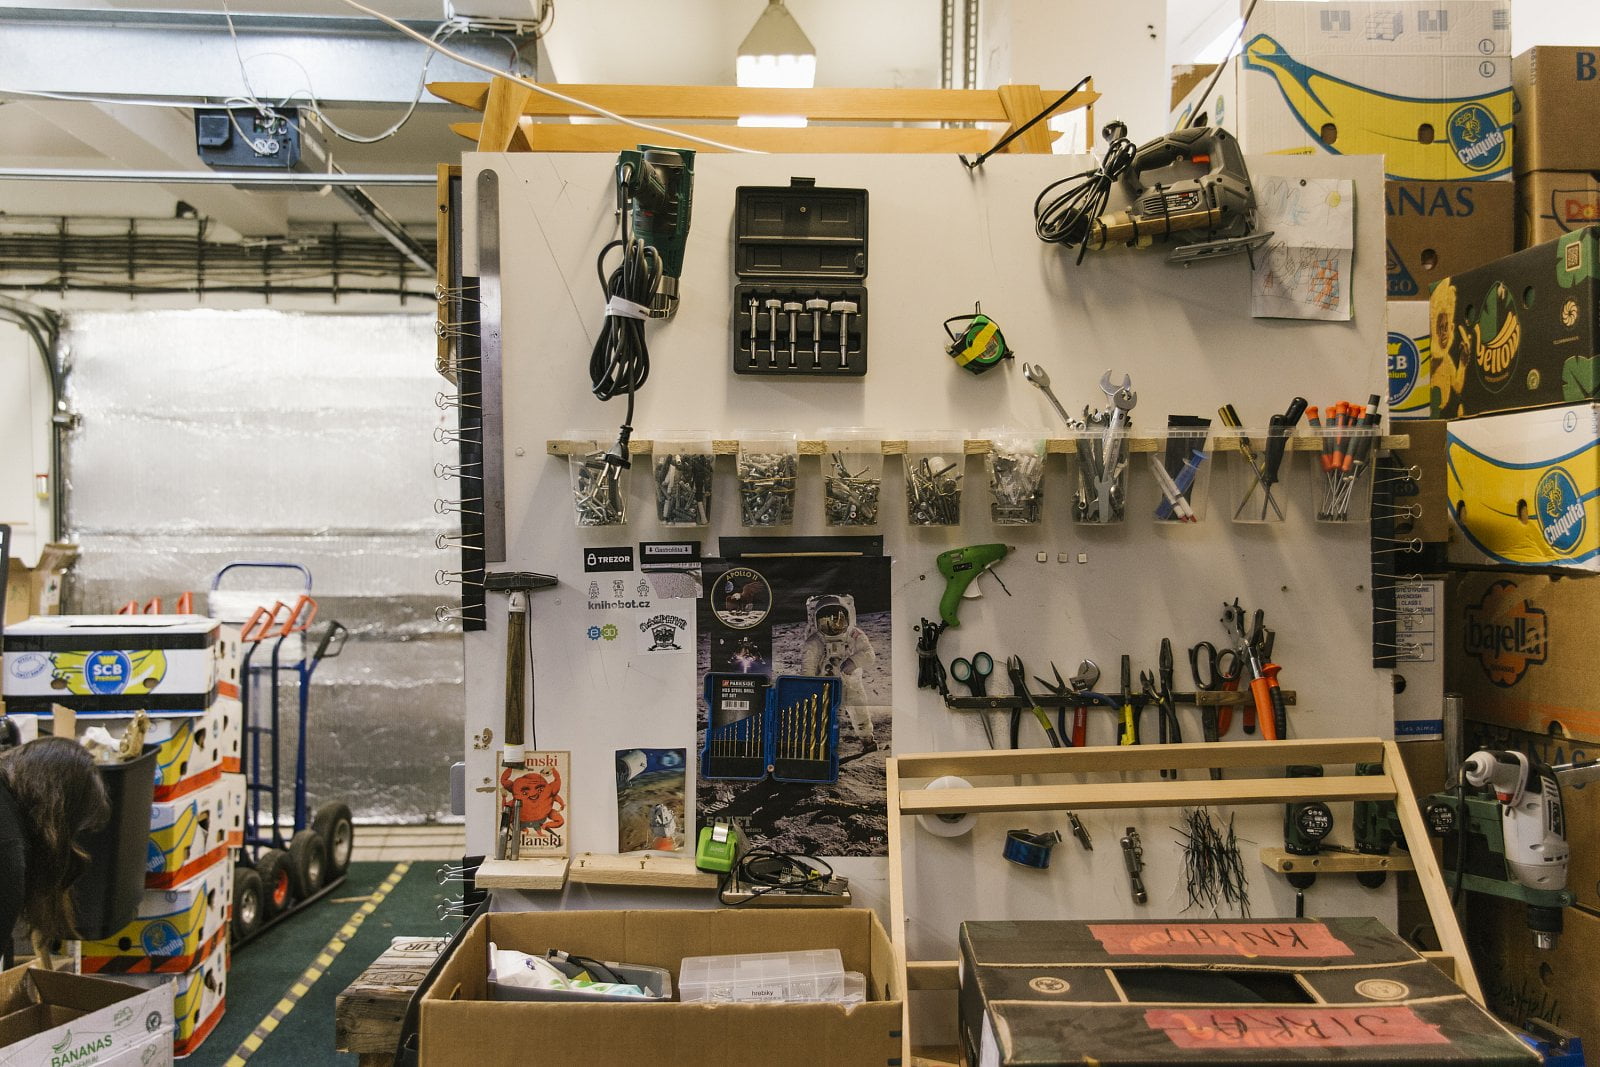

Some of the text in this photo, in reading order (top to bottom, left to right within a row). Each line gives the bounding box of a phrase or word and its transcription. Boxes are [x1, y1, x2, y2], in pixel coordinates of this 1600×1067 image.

[1457, 131, 1504, 164] Chiquita
[1387, 355, 1408, 370] CB
[1544, 502, 1585, 545] Chiquita
[597, 555, 631, 563] TREZOR
[726, 571, 752, 581] APOLLO
[587, 600, 651, 610] knihobot.cz
[93, 663, 123, 676] SCB
[526, 754, 558, 767] mski
[1210, 1015, 1390, 1040] JIRKA
[51, 1034, 113, 1067] BANANAS
